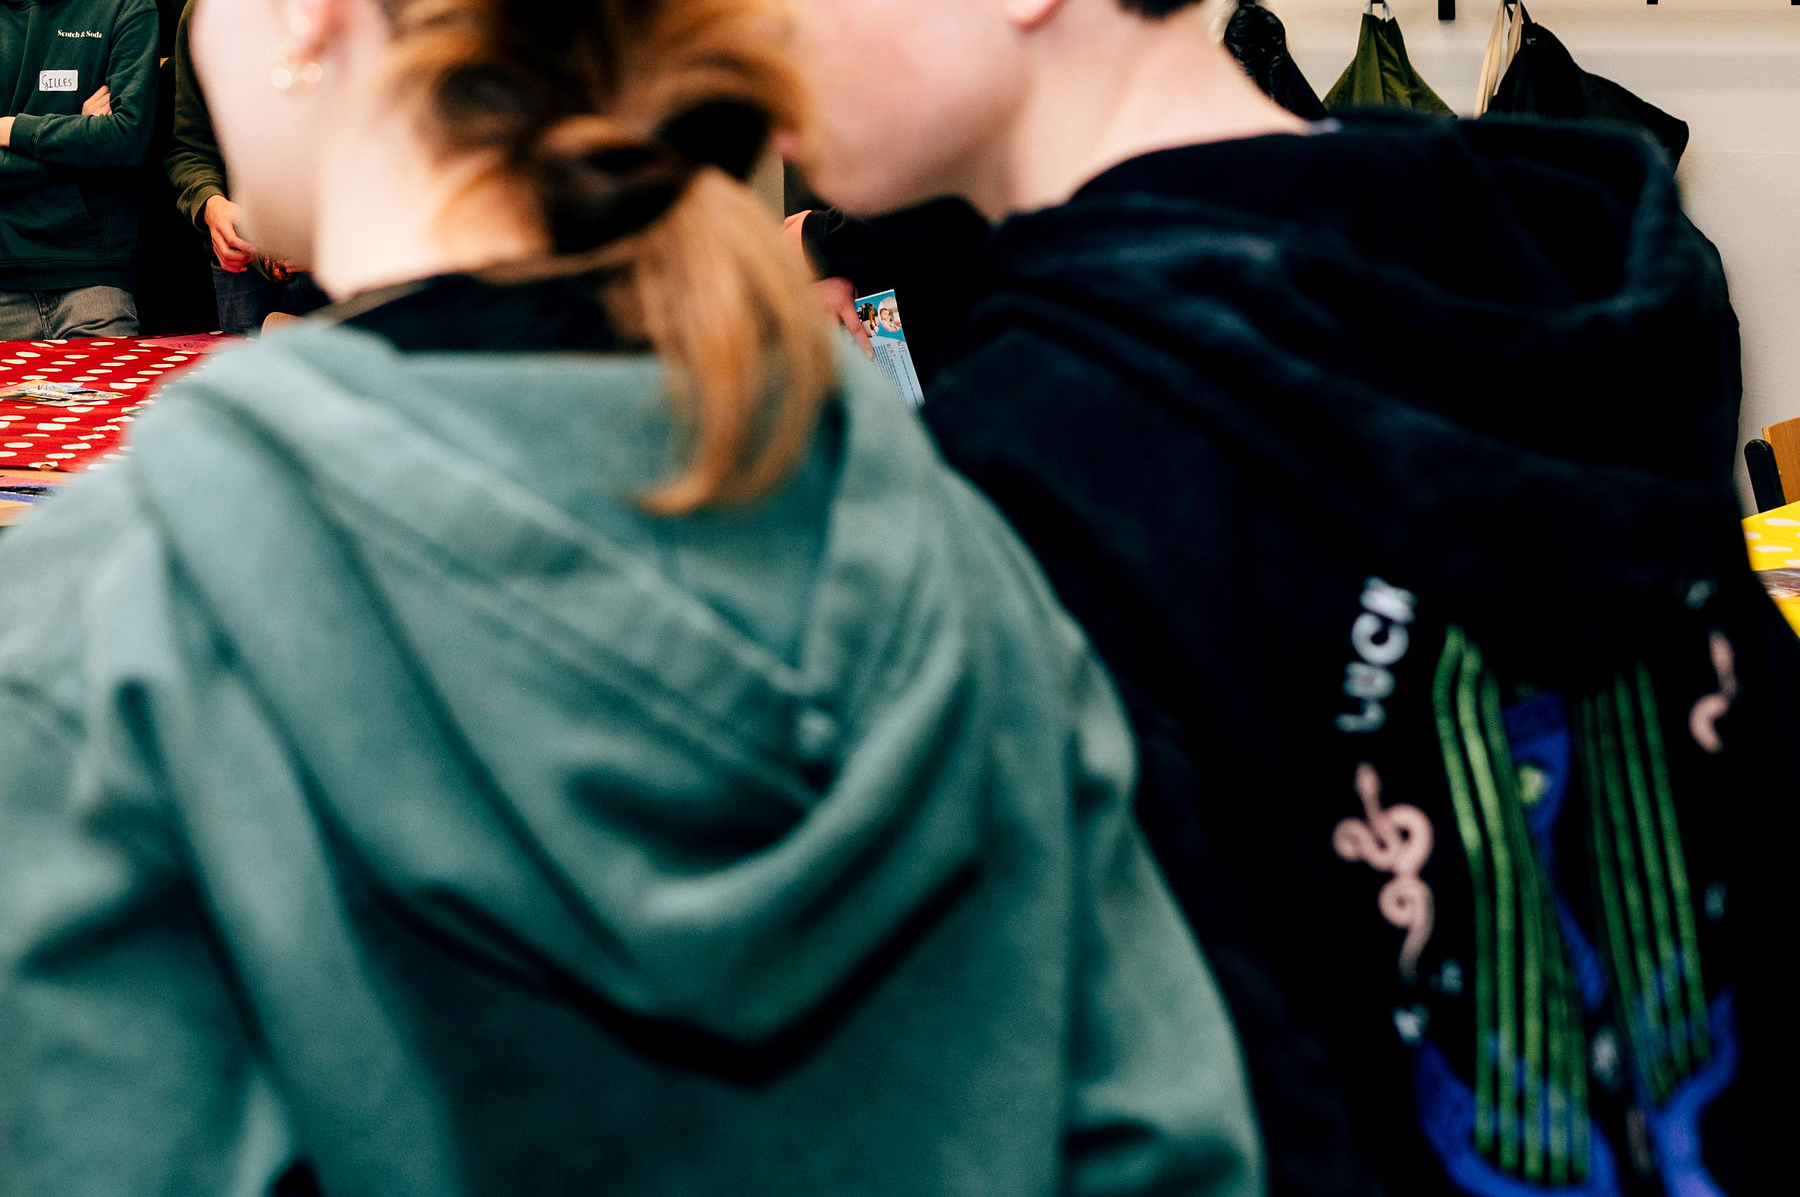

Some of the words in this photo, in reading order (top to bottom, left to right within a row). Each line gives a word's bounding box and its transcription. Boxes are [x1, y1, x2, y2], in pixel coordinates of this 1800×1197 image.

[57, 29, 80, 38] Scotch
[86, 30, 102, 38] Soda
[42, 74, 72, 90] GILLES
